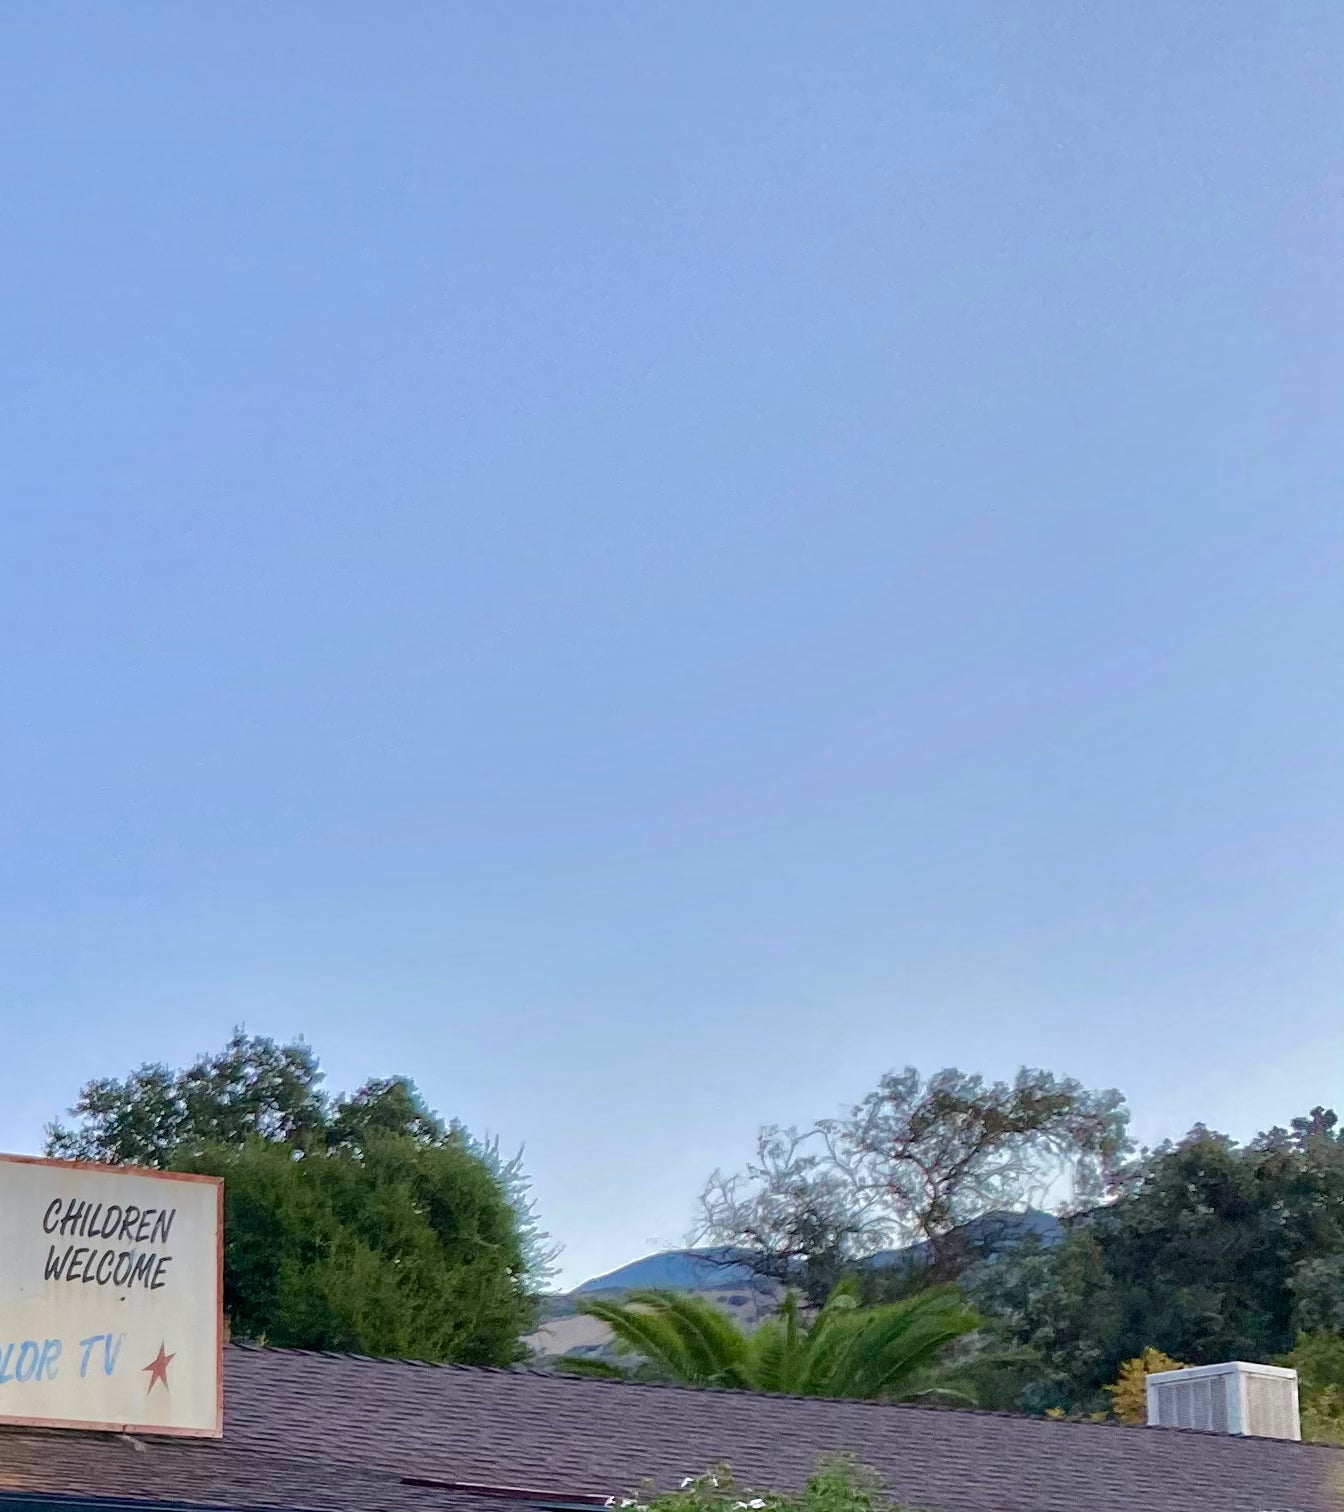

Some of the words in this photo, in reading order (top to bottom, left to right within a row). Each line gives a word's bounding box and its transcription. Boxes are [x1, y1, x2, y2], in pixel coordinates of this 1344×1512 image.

[42, 1197, 176, 1245] CHILDREN
[44, 1244, 173, 1290] WELCOME
[79, 1332, 127, 1378] TV
